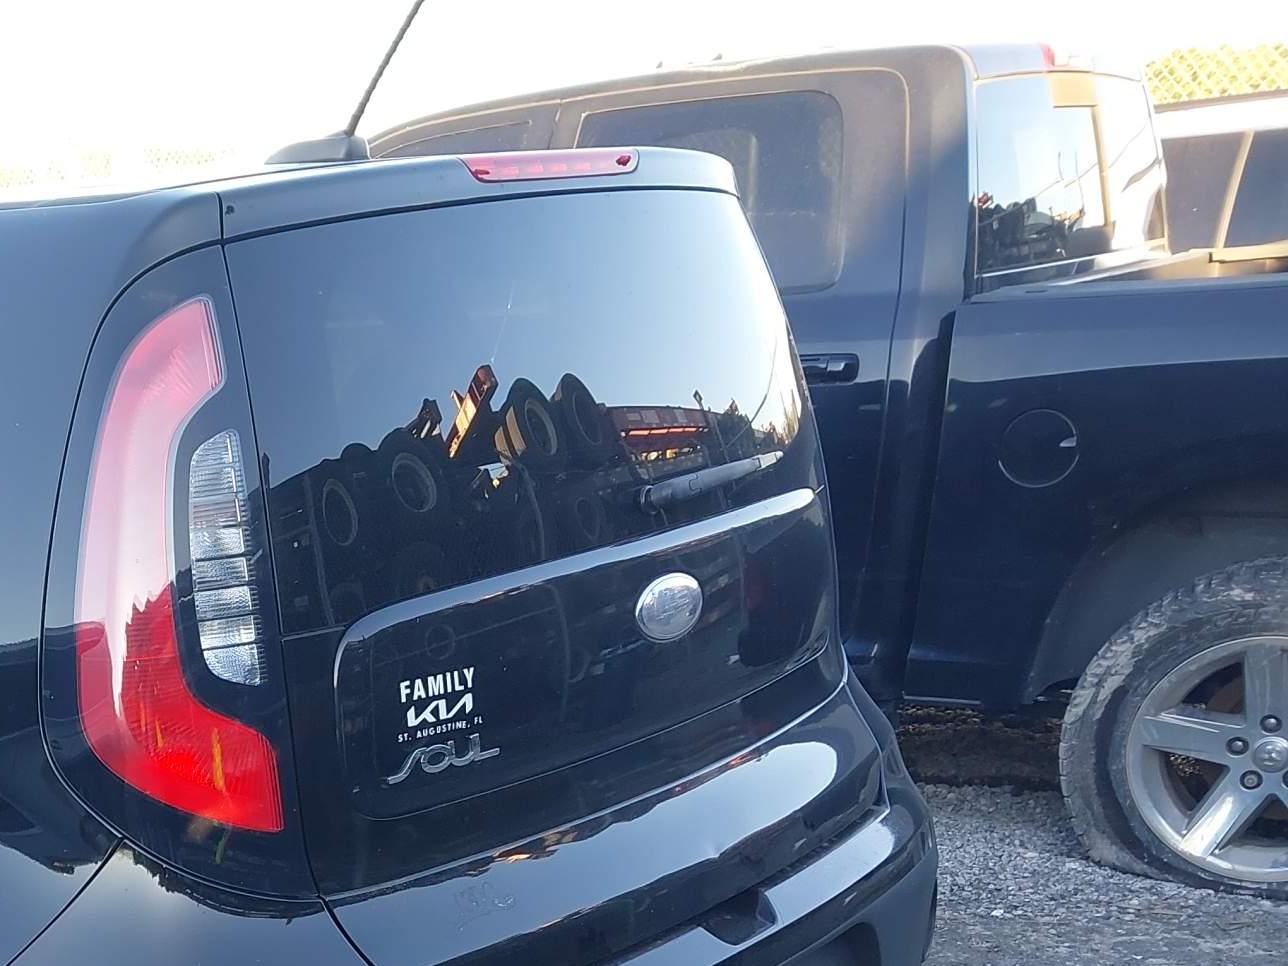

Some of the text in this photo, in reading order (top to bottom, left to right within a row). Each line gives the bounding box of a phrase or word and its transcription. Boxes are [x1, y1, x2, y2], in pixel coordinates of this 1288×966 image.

[399, 666, 475, 703] FAMILY
[397, 733, 412, 743] ST.
[474, 715, 484, 725] FL
